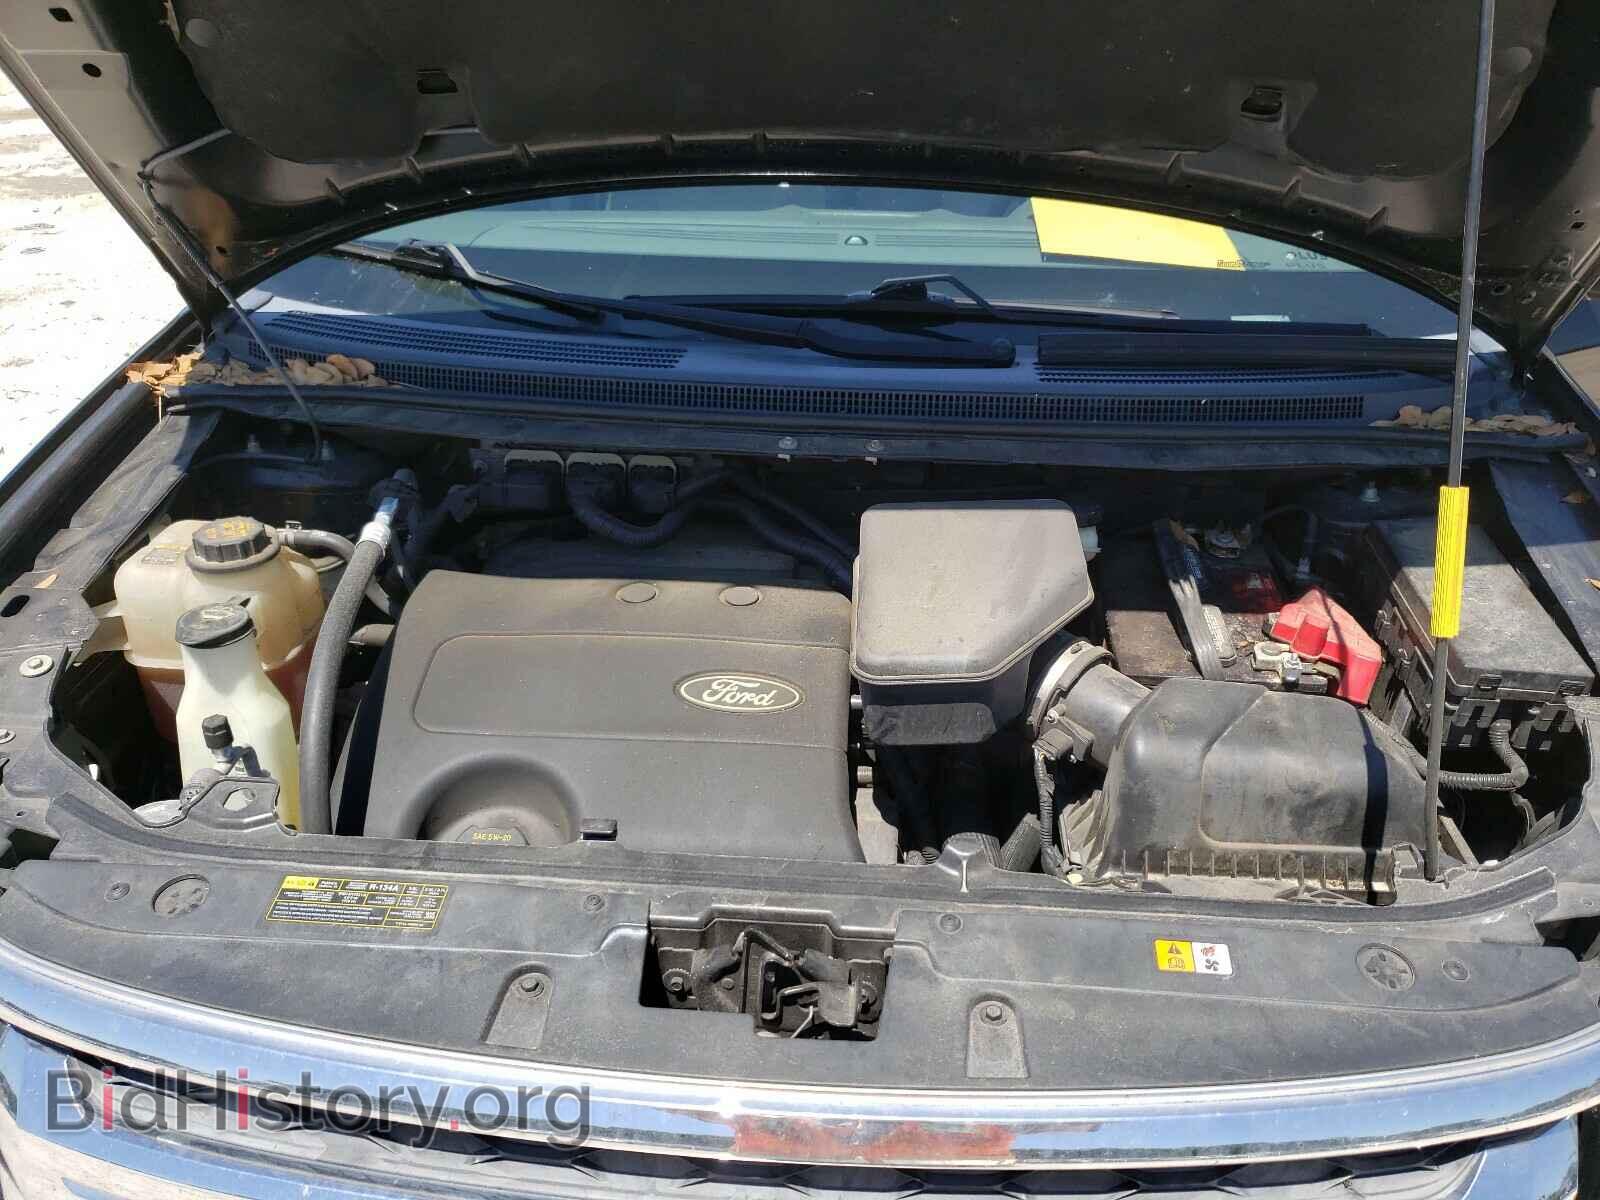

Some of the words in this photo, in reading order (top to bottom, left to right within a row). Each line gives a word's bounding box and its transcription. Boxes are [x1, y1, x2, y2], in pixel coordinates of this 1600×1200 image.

[702, 678, 777, 706] Ford
[471, 832, 487, 841] SAE
[488, 833, 512, 842] 5W-20
[368, 883, 400, 893] R-134A
